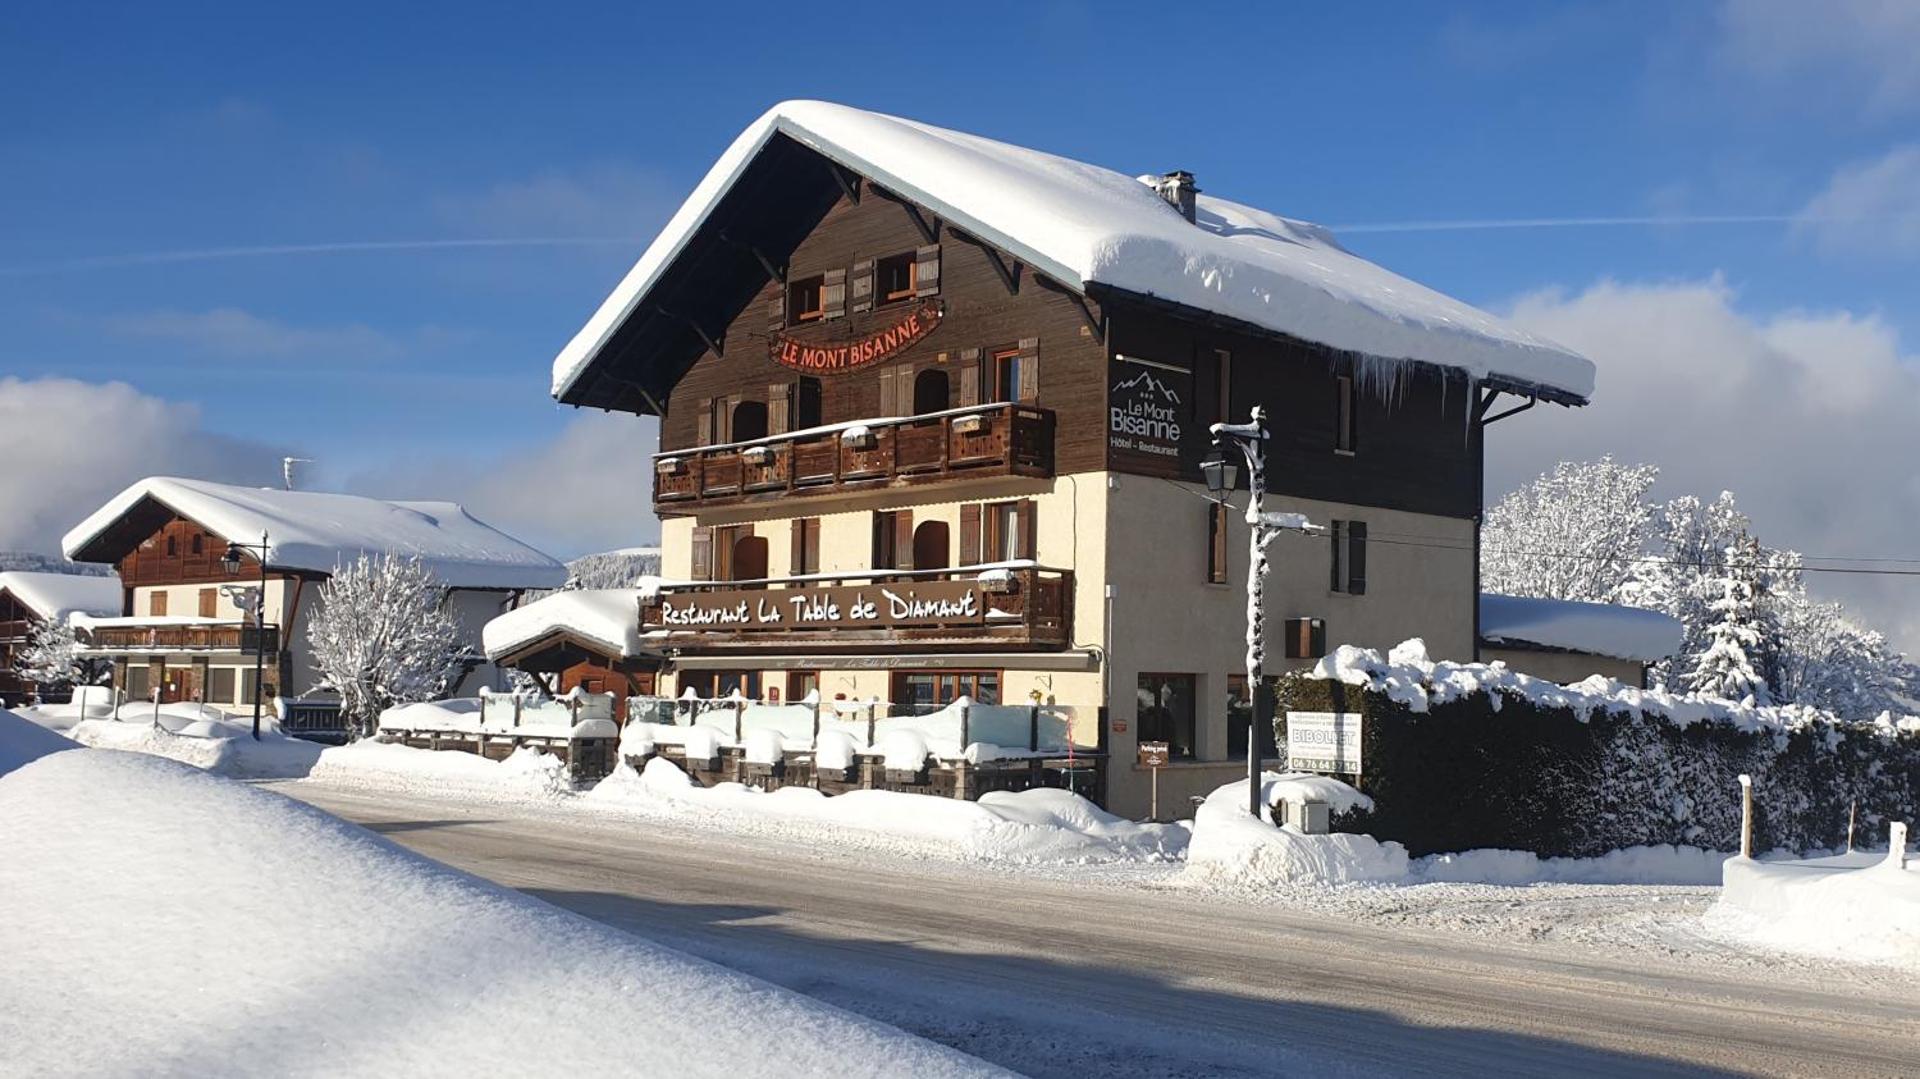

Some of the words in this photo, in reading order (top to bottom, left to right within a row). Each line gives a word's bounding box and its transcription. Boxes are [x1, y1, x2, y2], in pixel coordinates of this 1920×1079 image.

[781, 342, 797, 363] LE
[800, 348, 848, 368] MONT
[850, 315, 921, 364] BISANNE
[1128, 399, 1142, 416] Le
[1144, 401, 1176, 422] Mont
[1110, 407, 1181, 441] Bisanne
[1138, 441, 1179, 457] Restaurant
[850, 592, 877, 619] de
[1292, 728, 1357, 746] BIBOLLET
[1293, 758, 1304, 768] 06
[1306, 758, 1317, 769] 76
[1319, 759, 1330, 770] 64
[1346, 760, 1357, 772] 14
